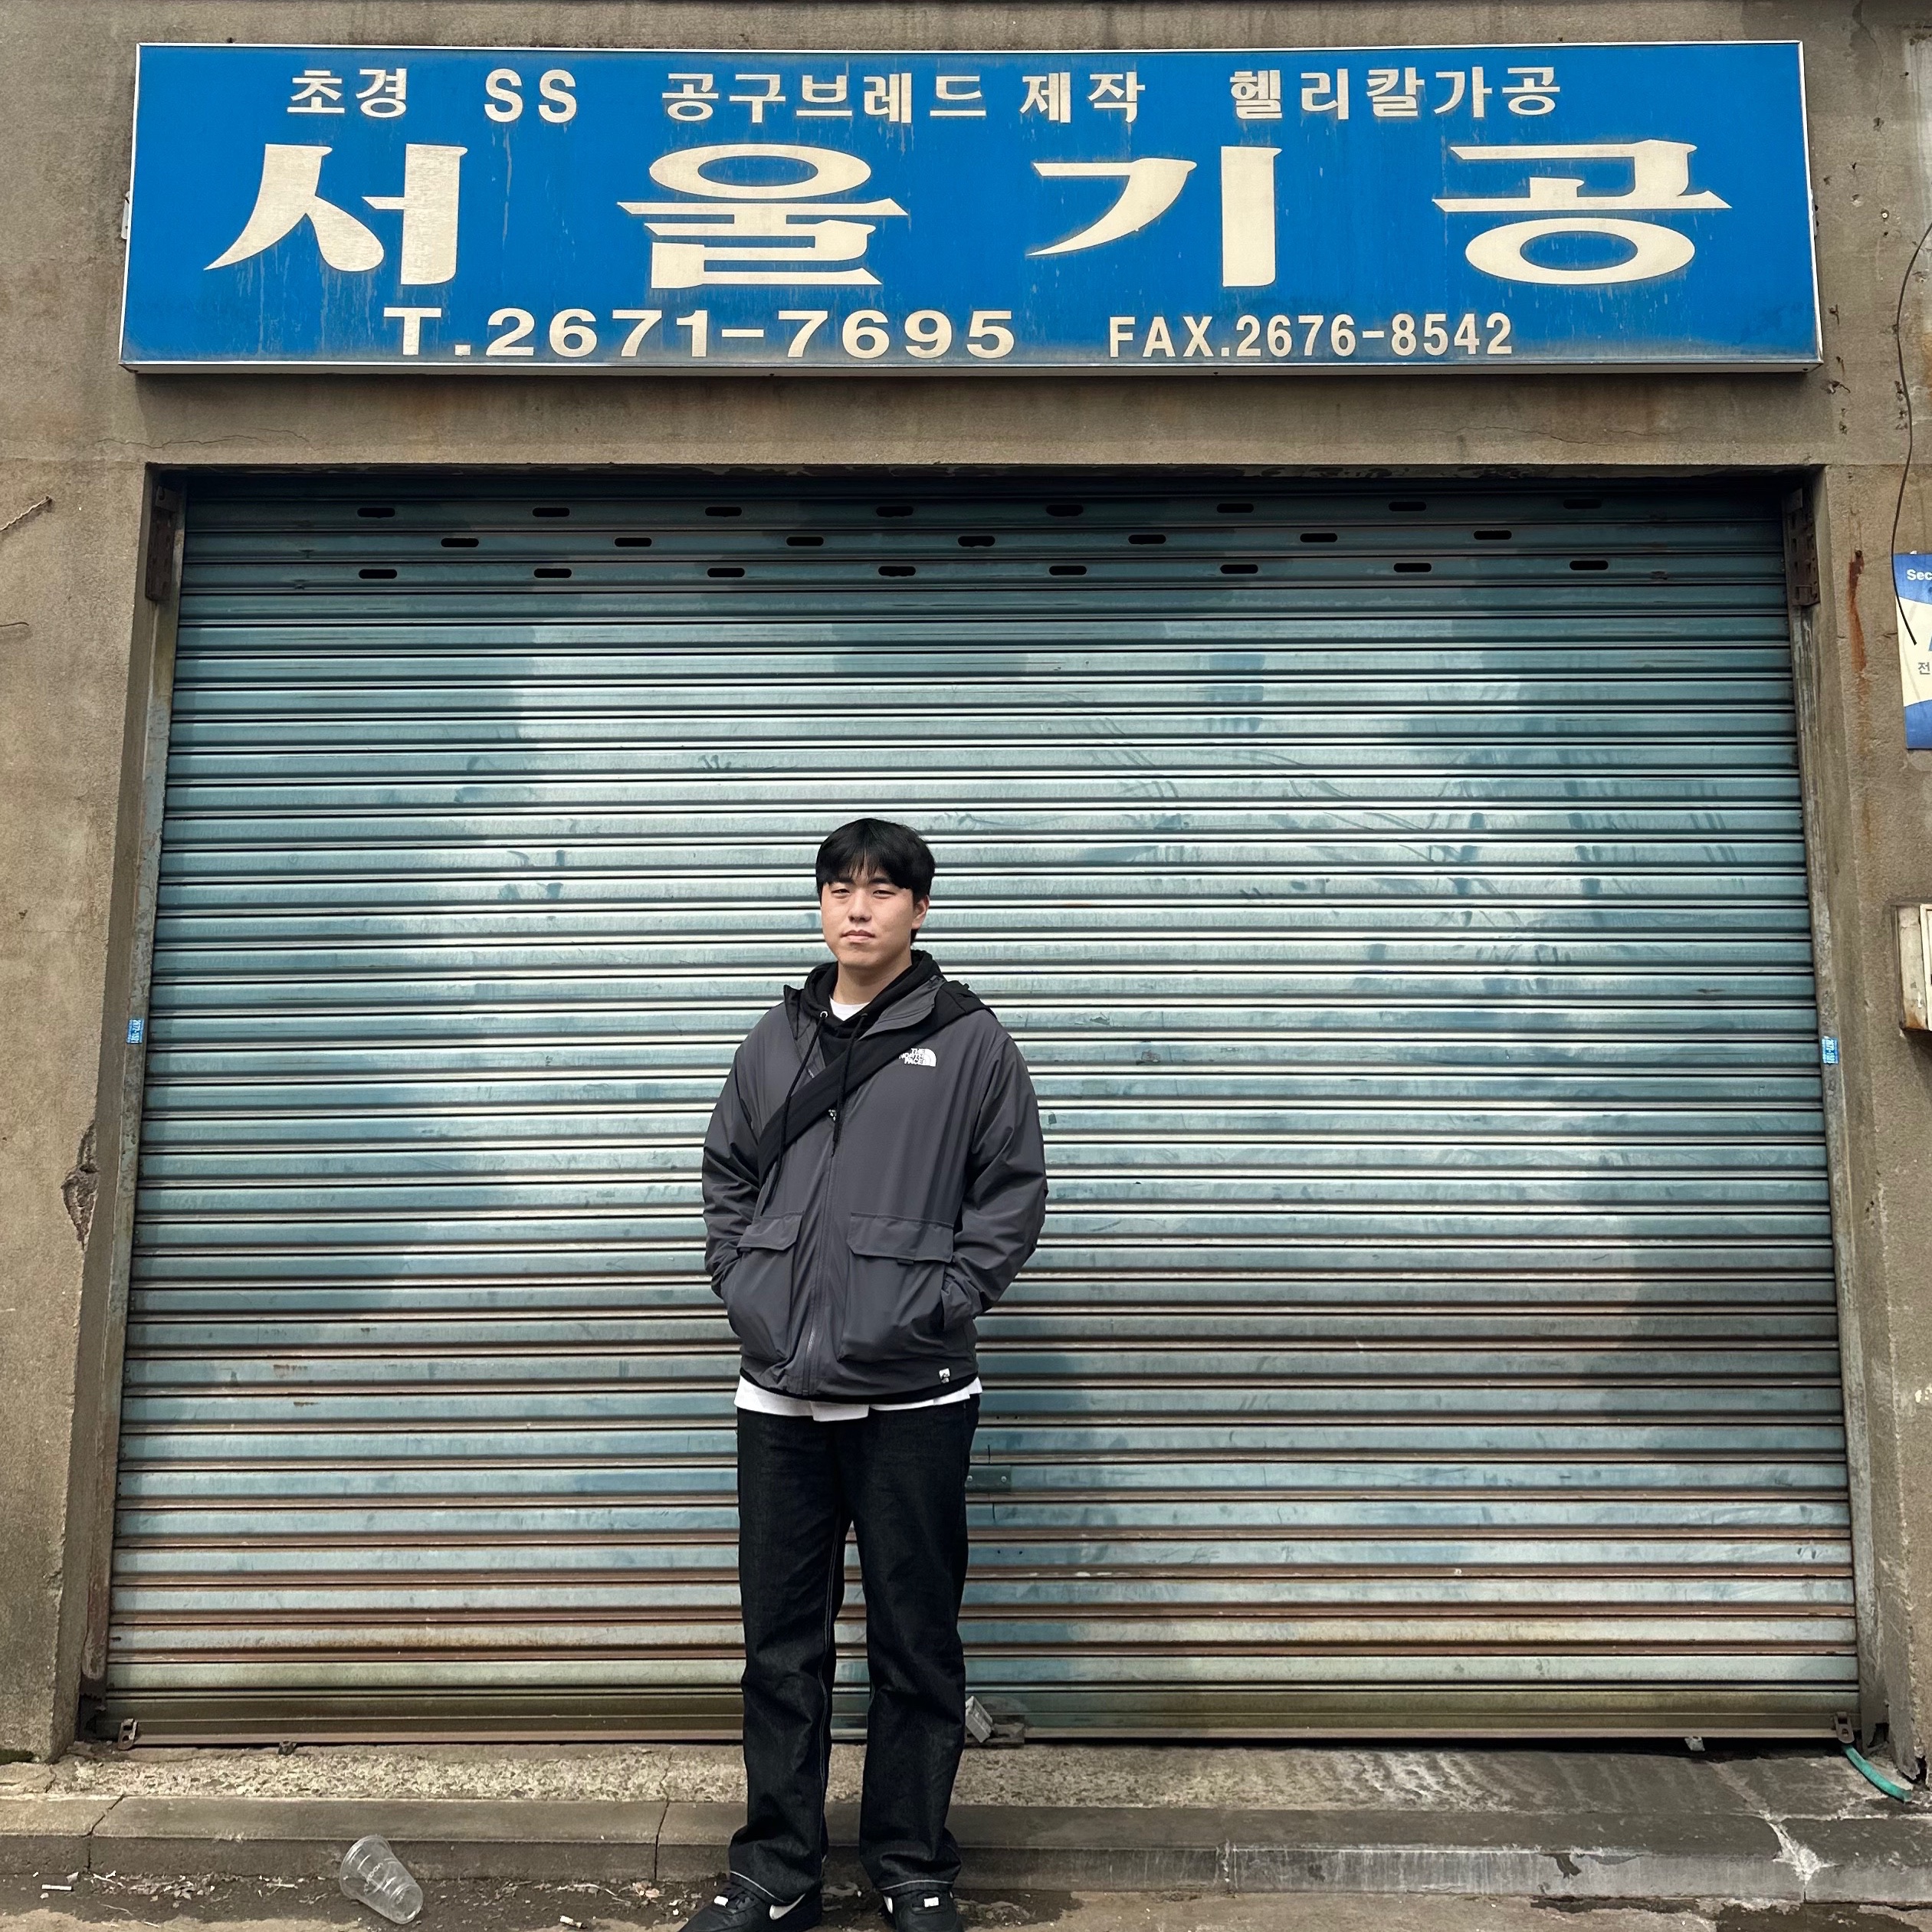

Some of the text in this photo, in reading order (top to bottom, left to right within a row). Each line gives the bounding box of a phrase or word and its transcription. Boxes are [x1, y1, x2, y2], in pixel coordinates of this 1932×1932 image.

[287, 67, 1560, 124] 초경 SS 공구브레드 제작 헬리칼가공
[204, 139, 1733, 289] 서울기공
[383, 307, 1514, 359] T.2671-7695 FAX.2676-8542
